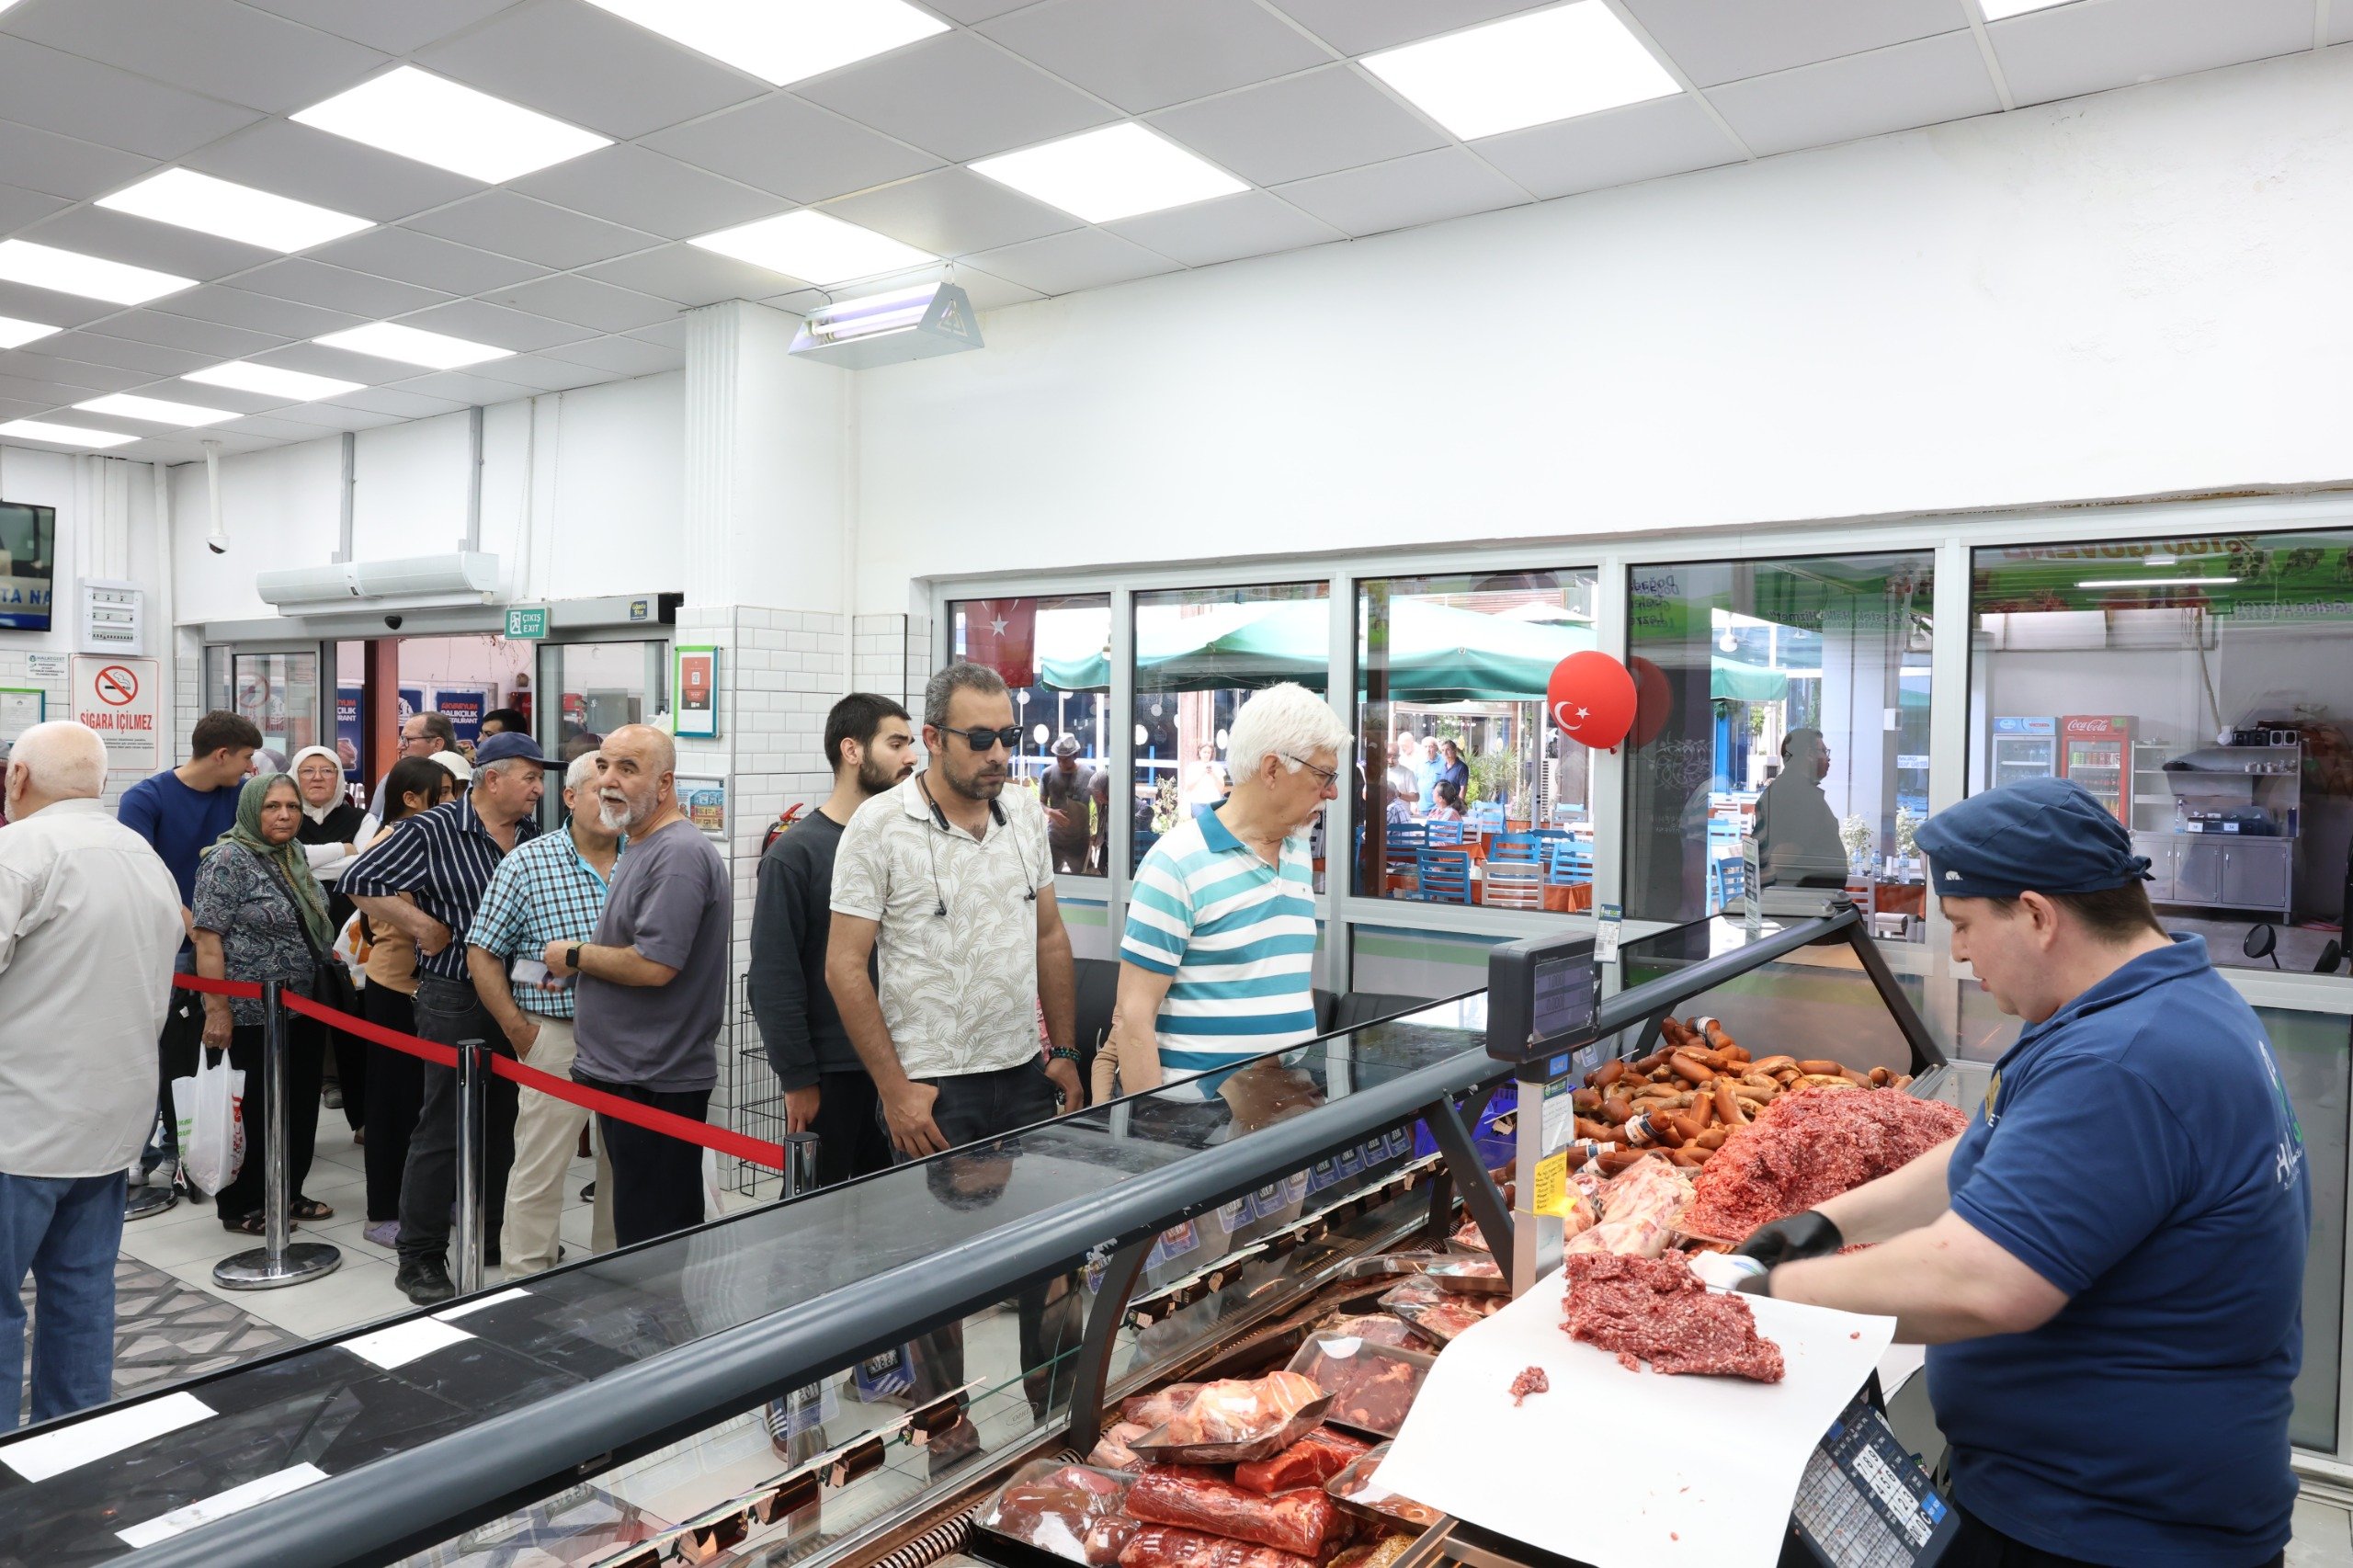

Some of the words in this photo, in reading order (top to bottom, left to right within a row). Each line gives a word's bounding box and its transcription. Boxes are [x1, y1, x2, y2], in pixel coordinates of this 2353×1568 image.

[522, 613, 541, 623] ÇIKIŞ
[523, 624, 540, 632] EXIT
[80, 709, 114, 730] SİGARA
[116, 710, 153, 734] İÇİLMEZ
[1857, 1462, 1868, 1475] 7
[1862, 1456, 1873, 1469] 8
[1875, 1483, 1885, 1495] 4
[1880, 1477, 1891, 1489] 5
[1898, 1497, 1909, 1510] 2
[1903, 1491, 1914, 1504] 3
[1919, 1511, 1932, 1525] C
